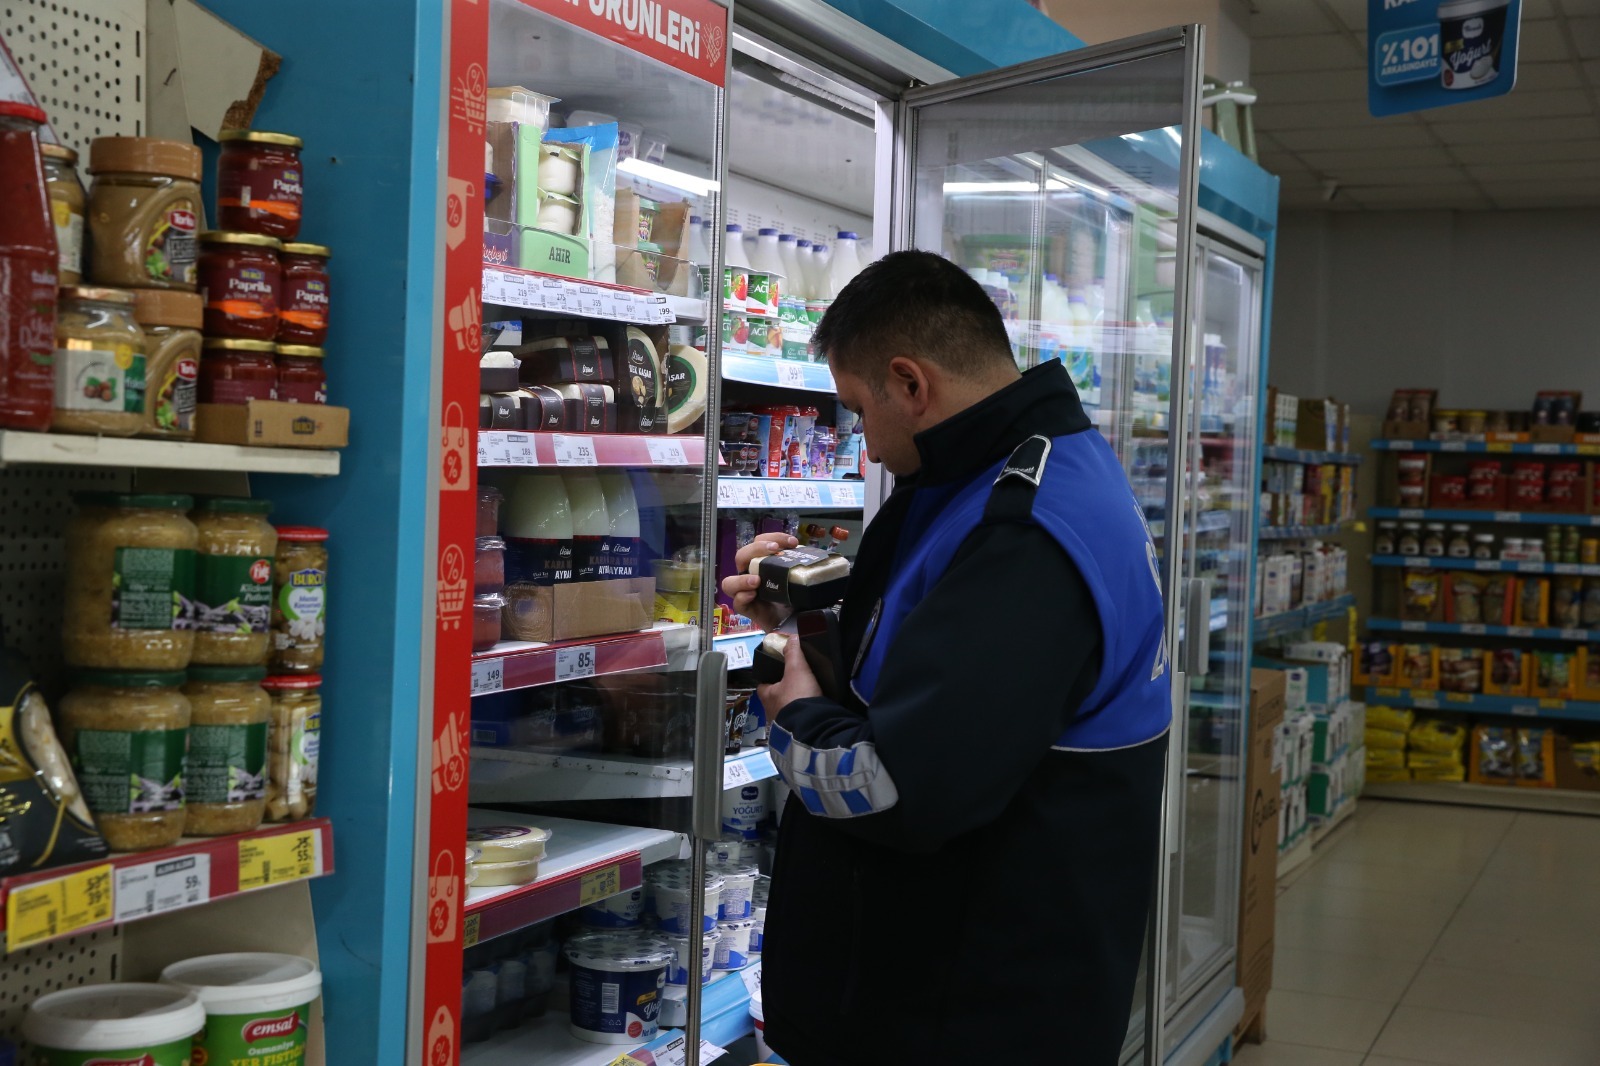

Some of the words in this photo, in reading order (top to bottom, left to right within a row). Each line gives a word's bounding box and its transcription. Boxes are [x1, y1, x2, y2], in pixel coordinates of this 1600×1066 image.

[1382, 34, 1439, 66] %101
[1381, 57, 1438, 76] ARKASINDAYIZ
[229, 278, 272, 294] Paprika
[659, 307, 670, 316] 199
[578, 447, 590, 457] 235
[734, 645, 744, 658] 17
[578, 652, 590, 667] 85
[487, 669, 500, 680] 149
[733, 806, 763, 815] YOĞURT
[297, 849, 309, 862] 55
[186, 875, 198, 889] 59
[251, 1017, 294, 1037] emsal
